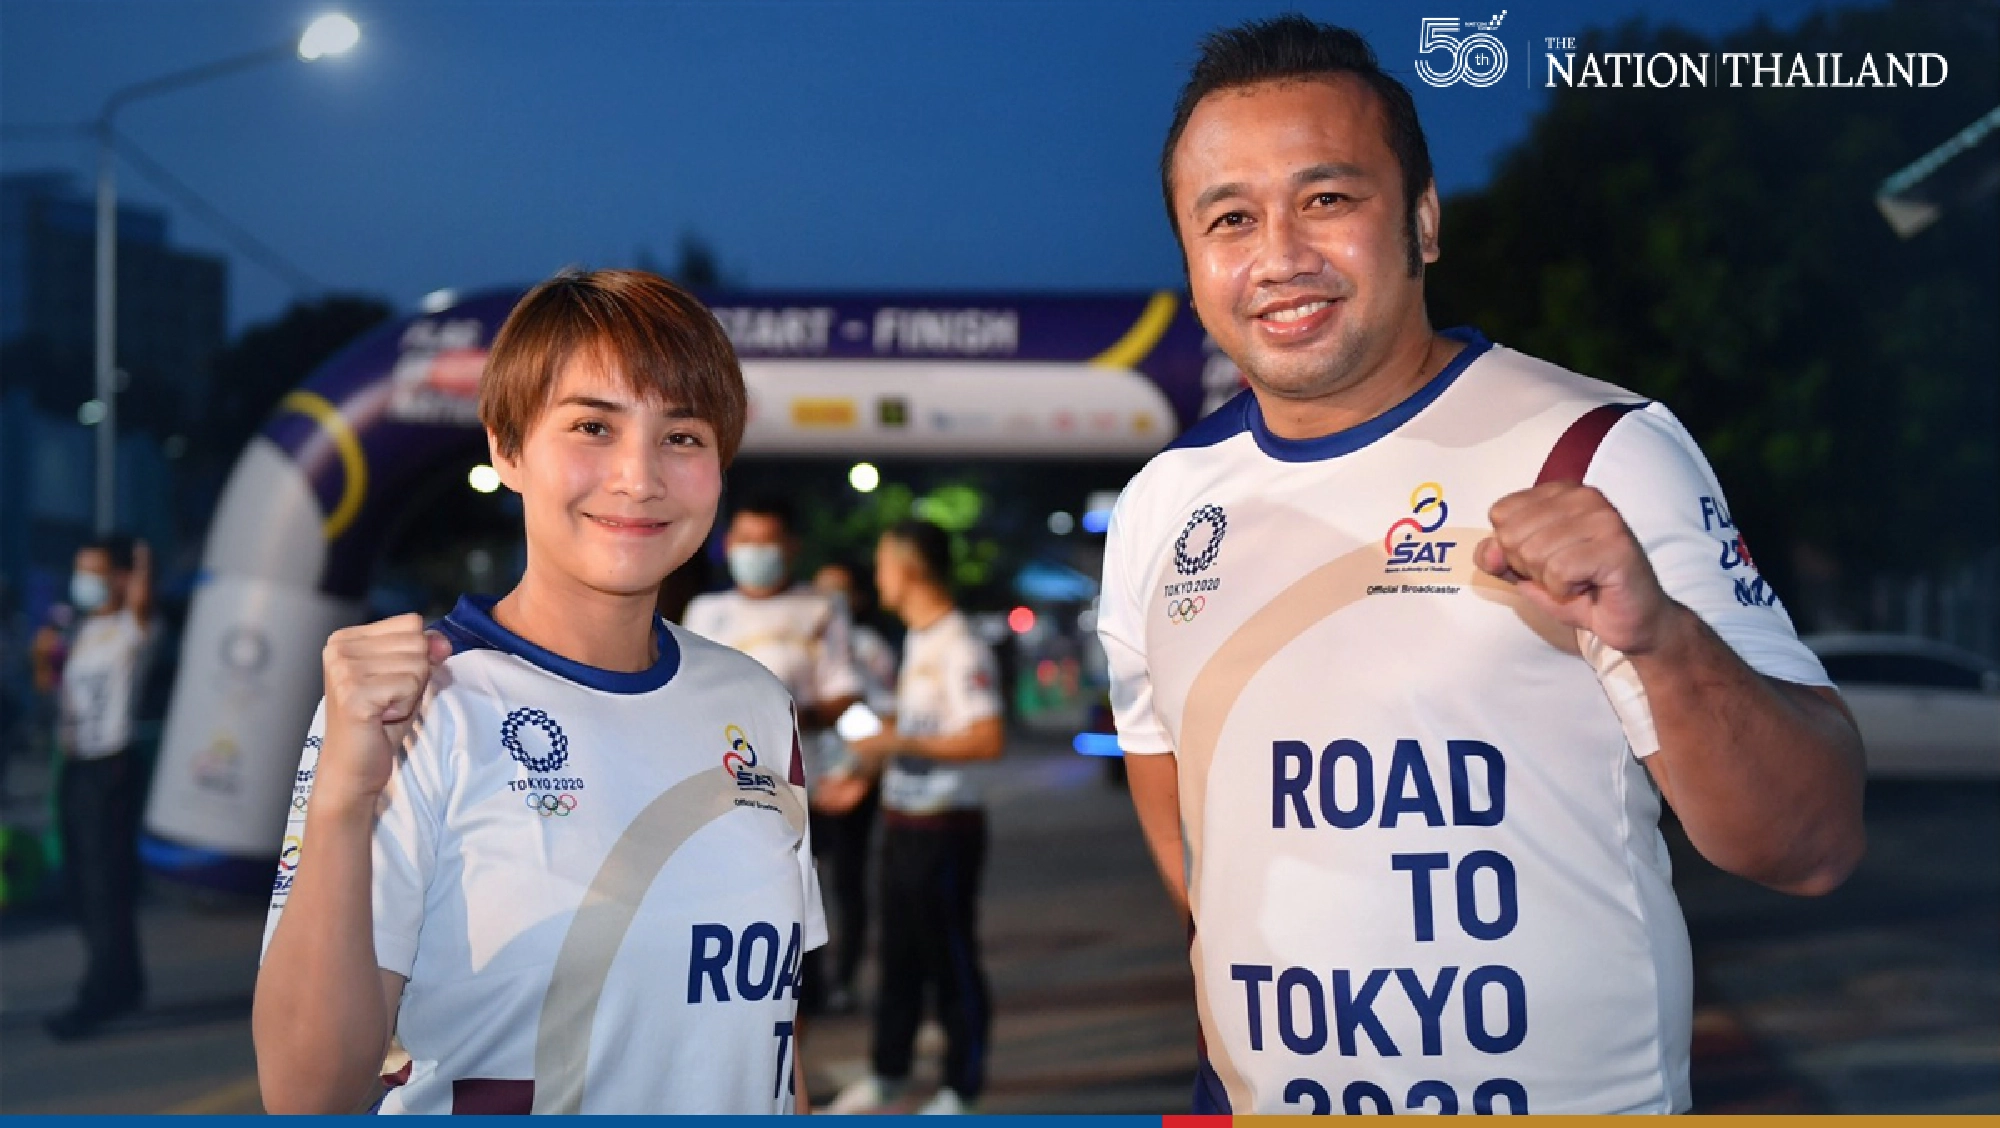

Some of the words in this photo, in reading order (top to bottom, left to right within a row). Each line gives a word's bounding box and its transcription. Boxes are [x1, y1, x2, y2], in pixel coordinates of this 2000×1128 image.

[872, 306, 1019, 354] FINISH
[1386, 541, 1457, 565] SAT
[1164, 580, 1193, 598] TOKYO
[1193, 577, 1221, 593] 2020
[507, 777, 551, 792] TOKYO
[552, 777, 584, 791] 2020
[1272, 738, 1506, 829] ROAD
[1391, 850, 1519, 942] TO
[686, 920, 803, 1004] ROA
[1230, 964, 1528, 1057] TOKYO
